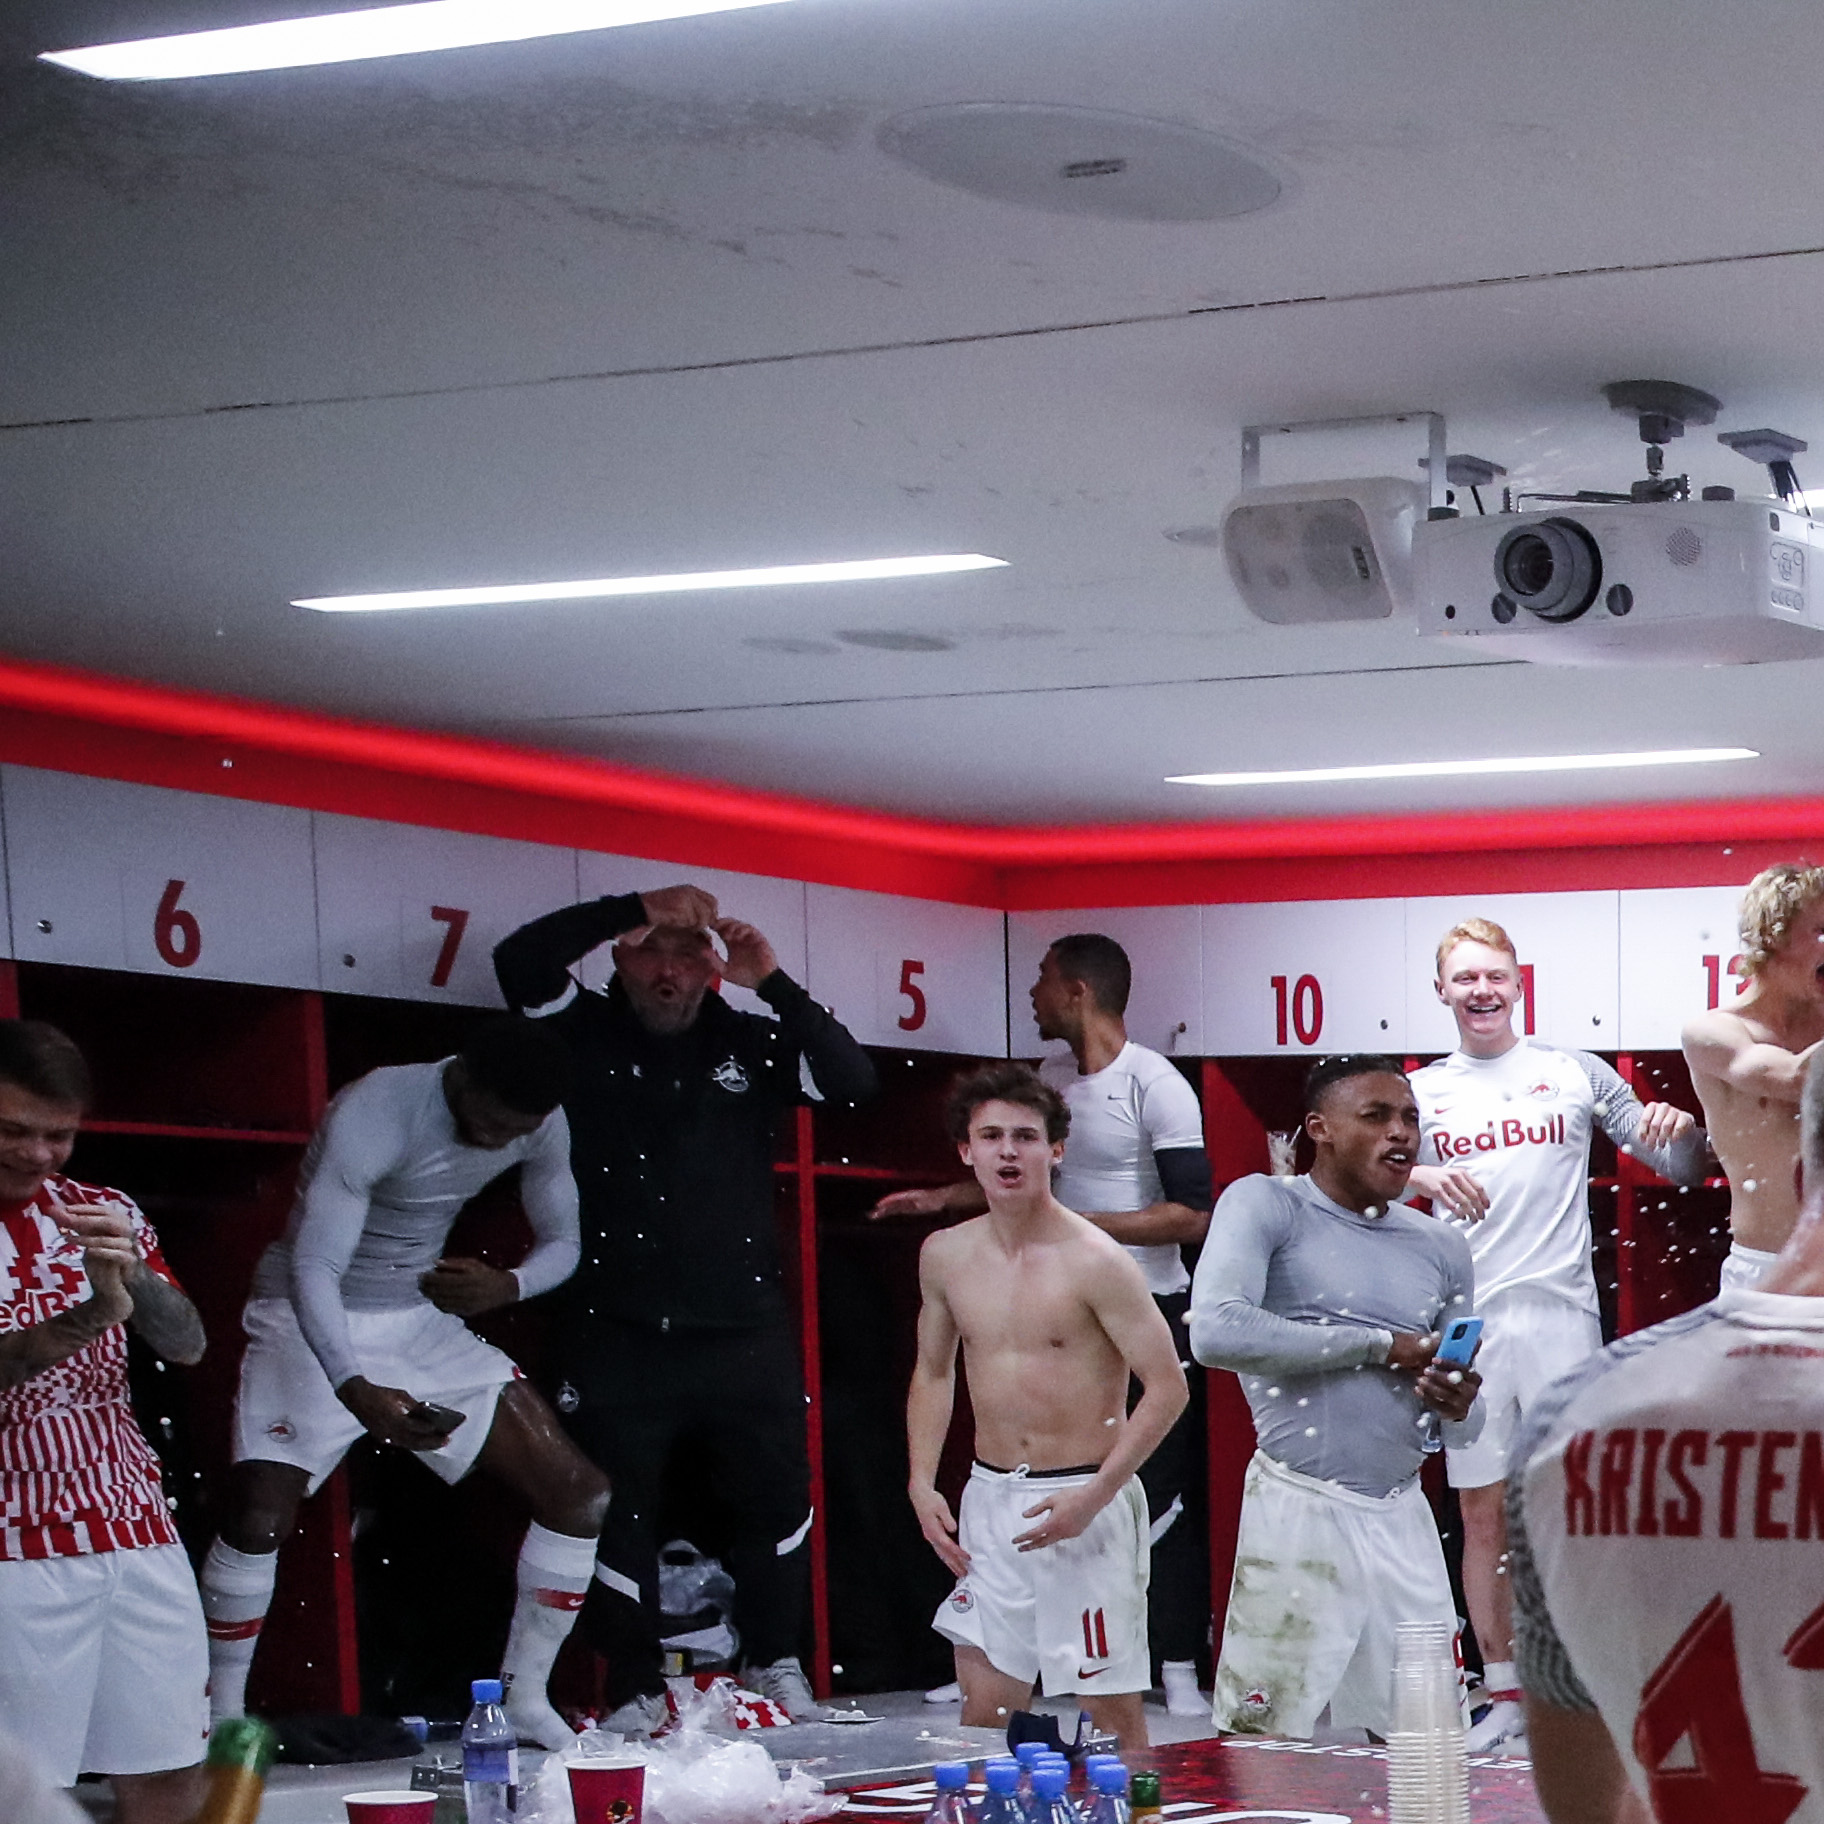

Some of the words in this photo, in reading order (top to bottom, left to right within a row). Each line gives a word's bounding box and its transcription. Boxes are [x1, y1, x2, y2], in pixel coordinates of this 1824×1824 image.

[154, 878, 202, 969] 6
[430, 905, 470, 988] 7
[897, 959, 927, 1032] 5
[1269, 973, 1324, 1047] 10
[1432, 1120, 1497, 1162] Red
[1501, 1113, 1565, 1148] Bull
[1081, 1606, 1109, 1659] 11
